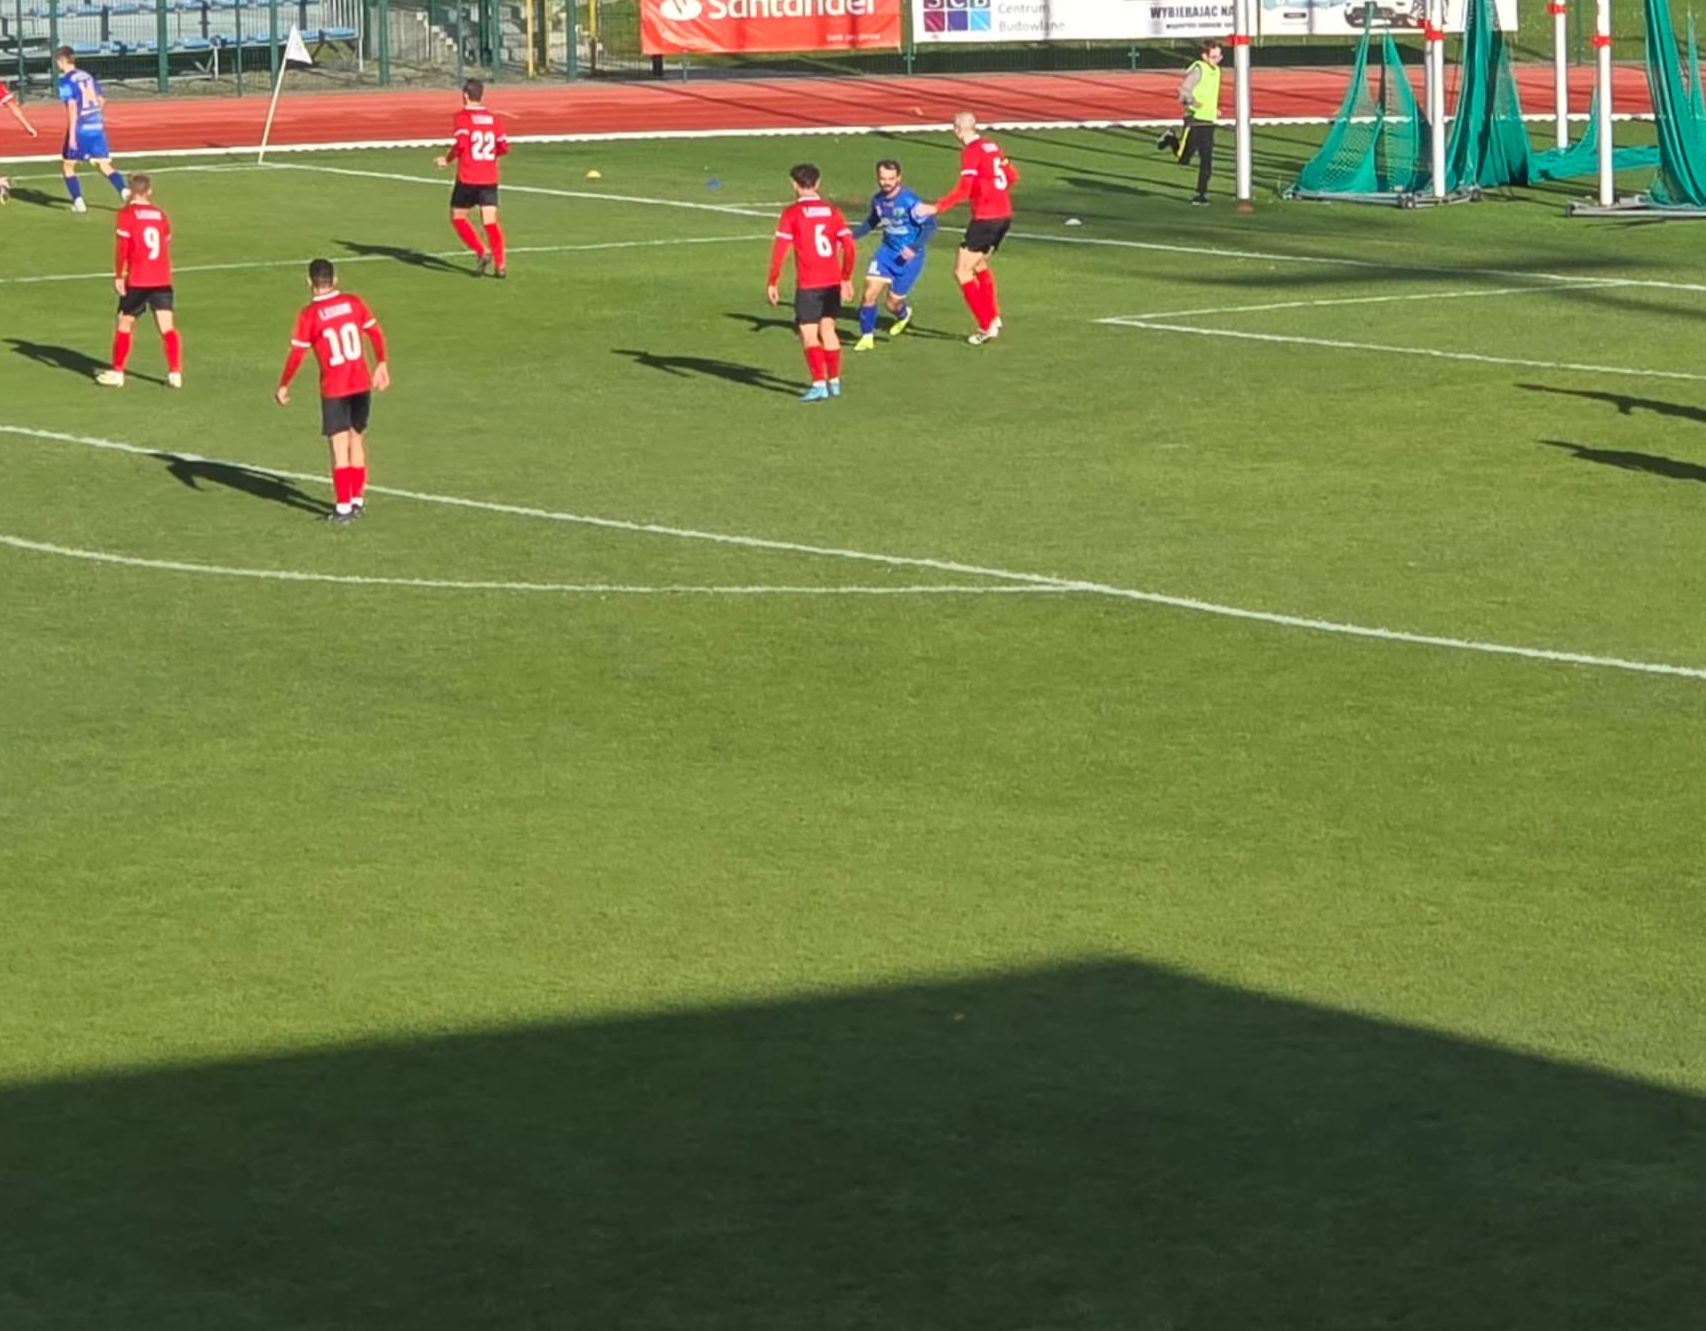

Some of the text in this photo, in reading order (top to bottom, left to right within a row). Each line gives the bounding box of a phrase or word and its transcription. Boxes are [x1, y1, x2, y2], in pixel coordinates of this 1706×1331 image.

[471, 130, 496, 161] 22
[993, 157, 1008, 190] 5
[143, 226, 160, 261] 9
[814, 224, 834, 257] 6
[322, 321, 362, 367] 10
